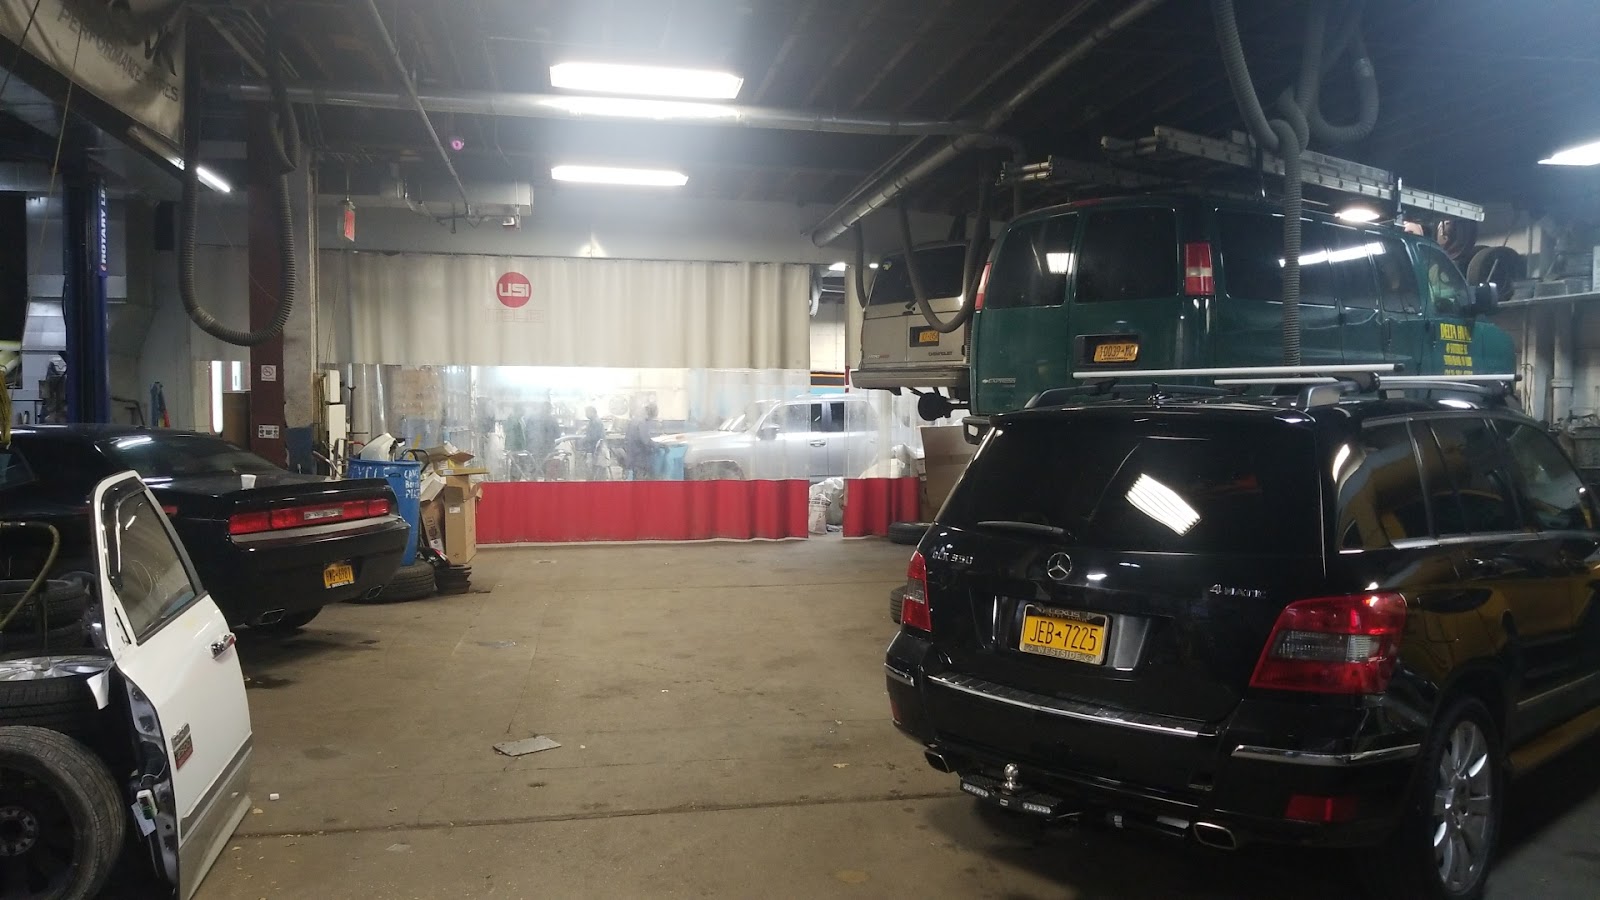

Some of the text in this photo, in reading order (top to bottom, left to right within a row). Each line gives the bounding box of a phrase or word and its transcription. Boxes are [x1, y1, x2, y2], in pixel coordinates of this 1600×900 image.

[499, 283, 529, 298] USI
[1049, 608, 1080, 618] LEXUS
[1038, 645, 1080, 659] WESTSIDE
